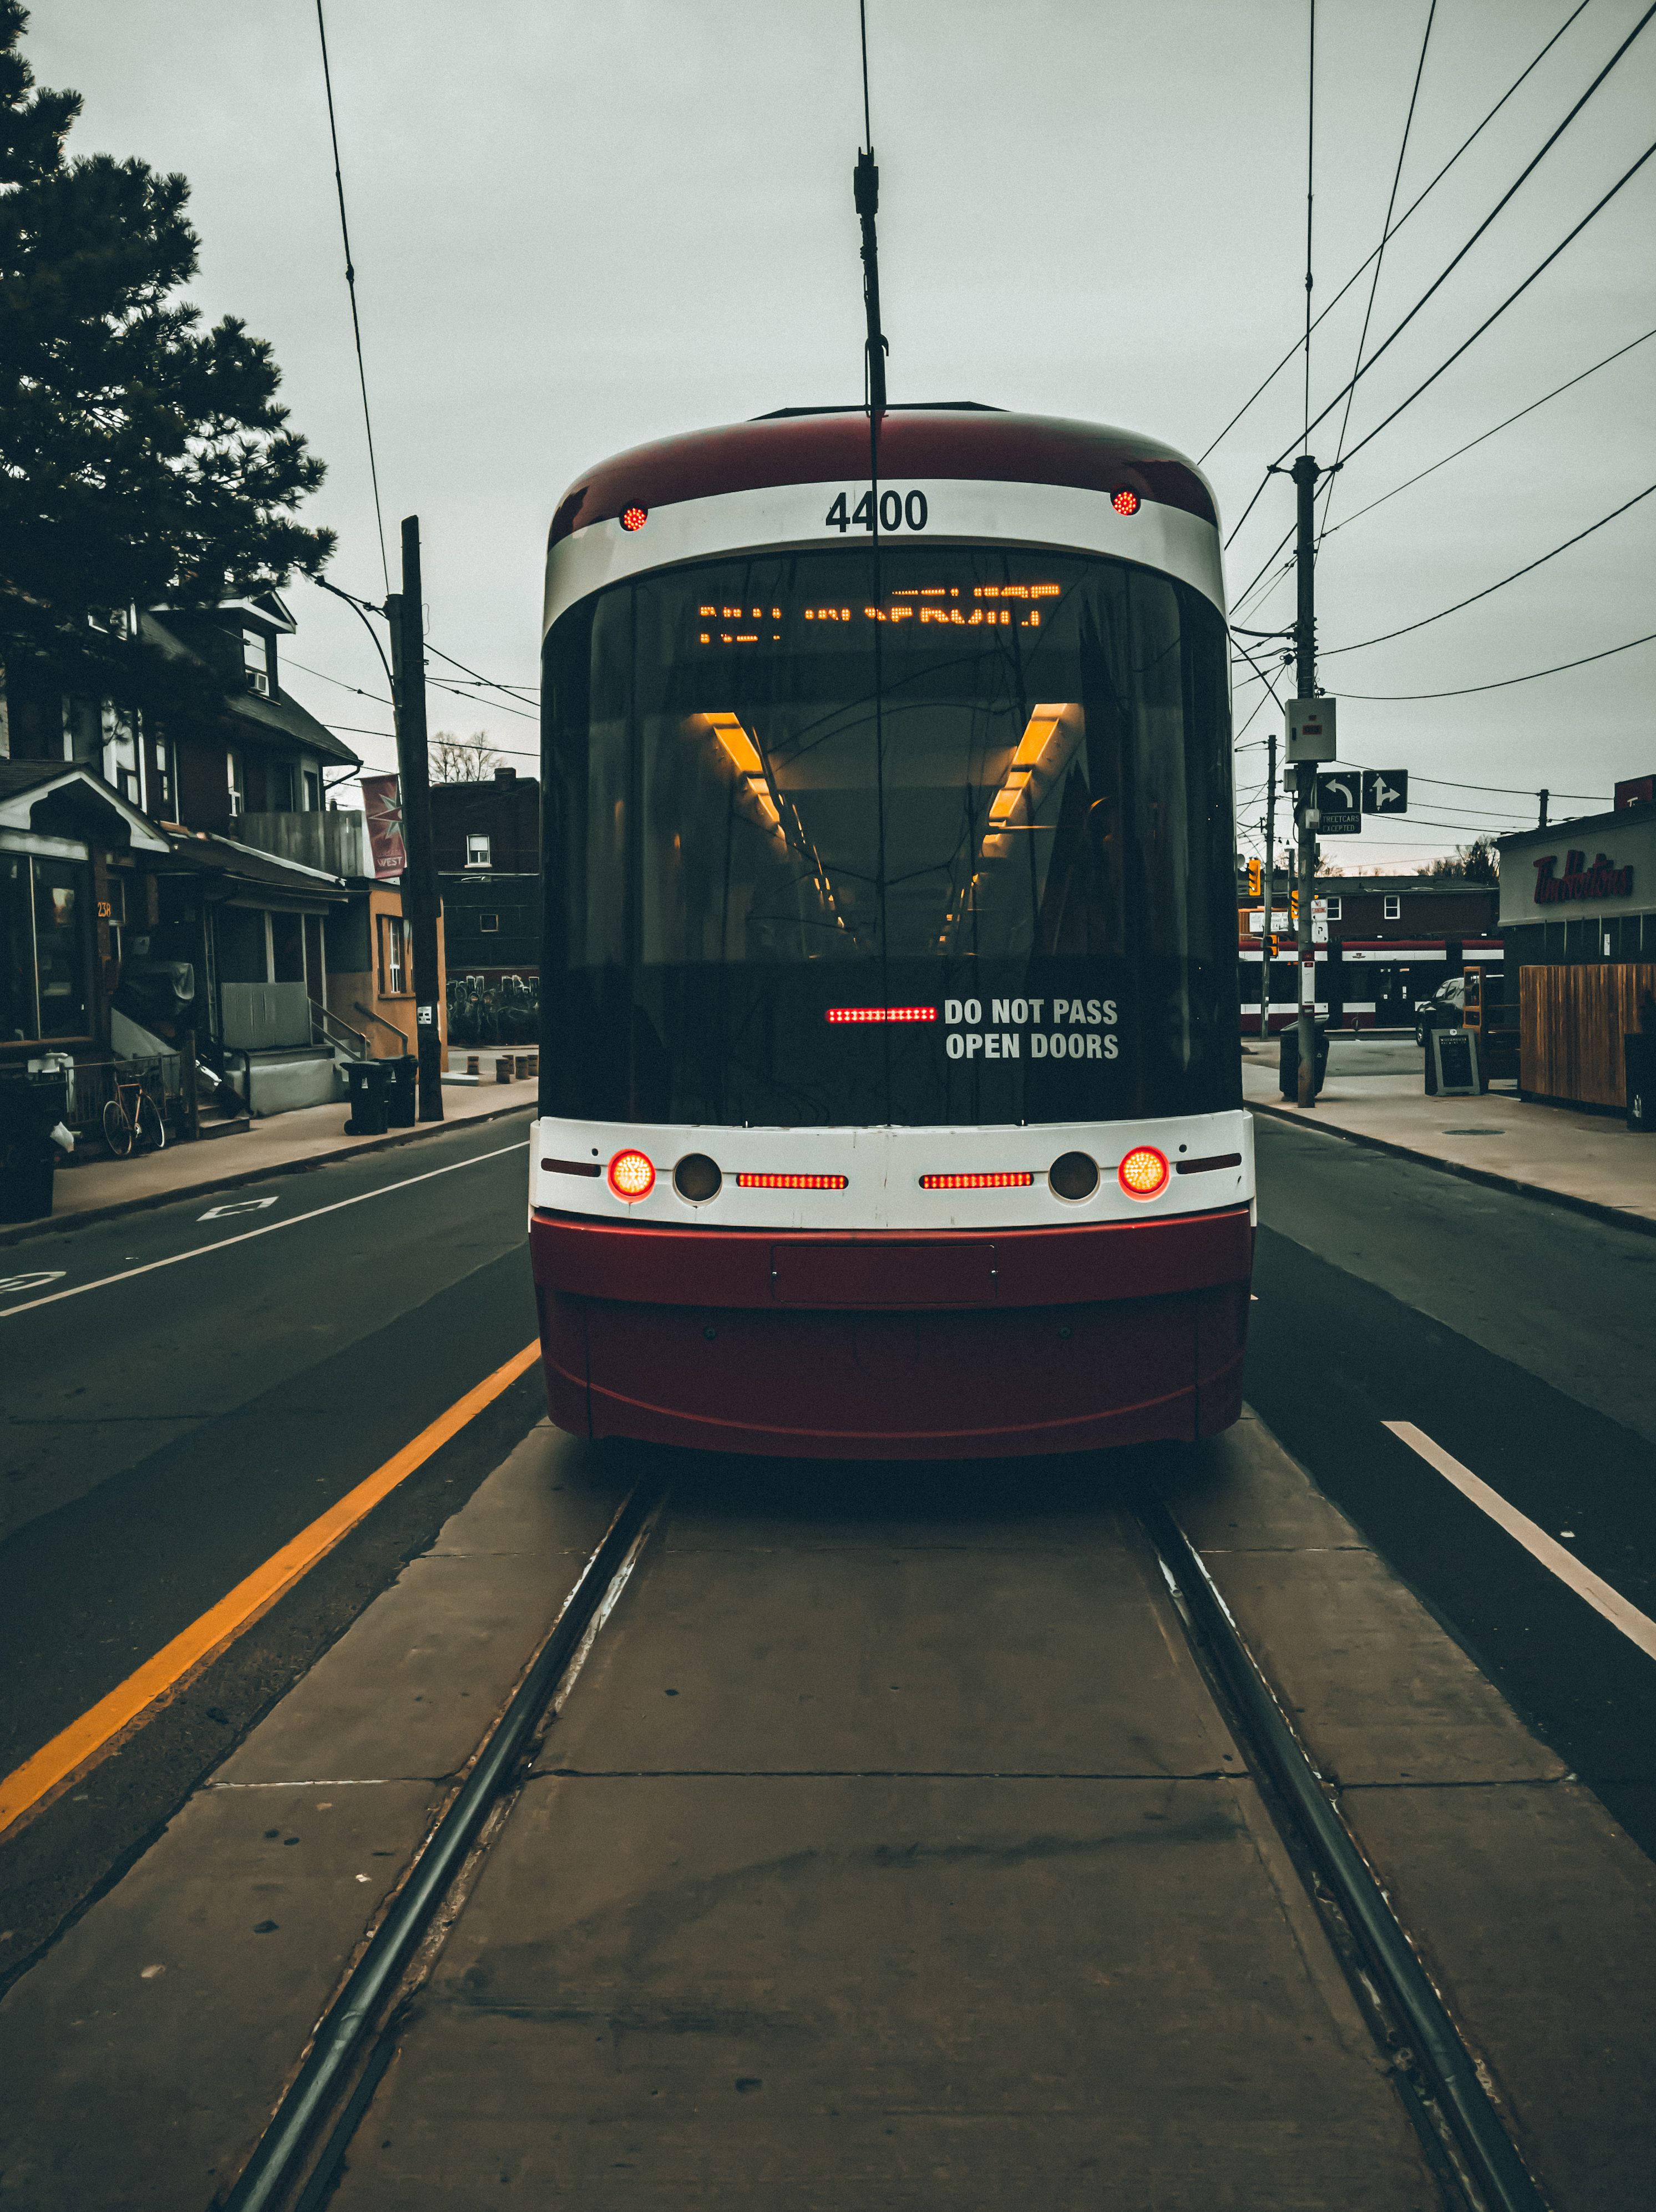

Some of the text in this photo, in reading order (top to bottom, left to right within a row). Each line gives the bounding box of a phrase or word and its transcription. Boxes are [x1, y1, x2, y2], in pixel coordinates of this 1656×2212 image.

[825, 490, 928, 532] 4400
[377, 856, 402, 867] WEST
[97, 902, 111, 917] 238
[944, 999, 1118, 1025] DO NOT PASS
[946, 1034, 1118, 1059] OPEN DOORS
